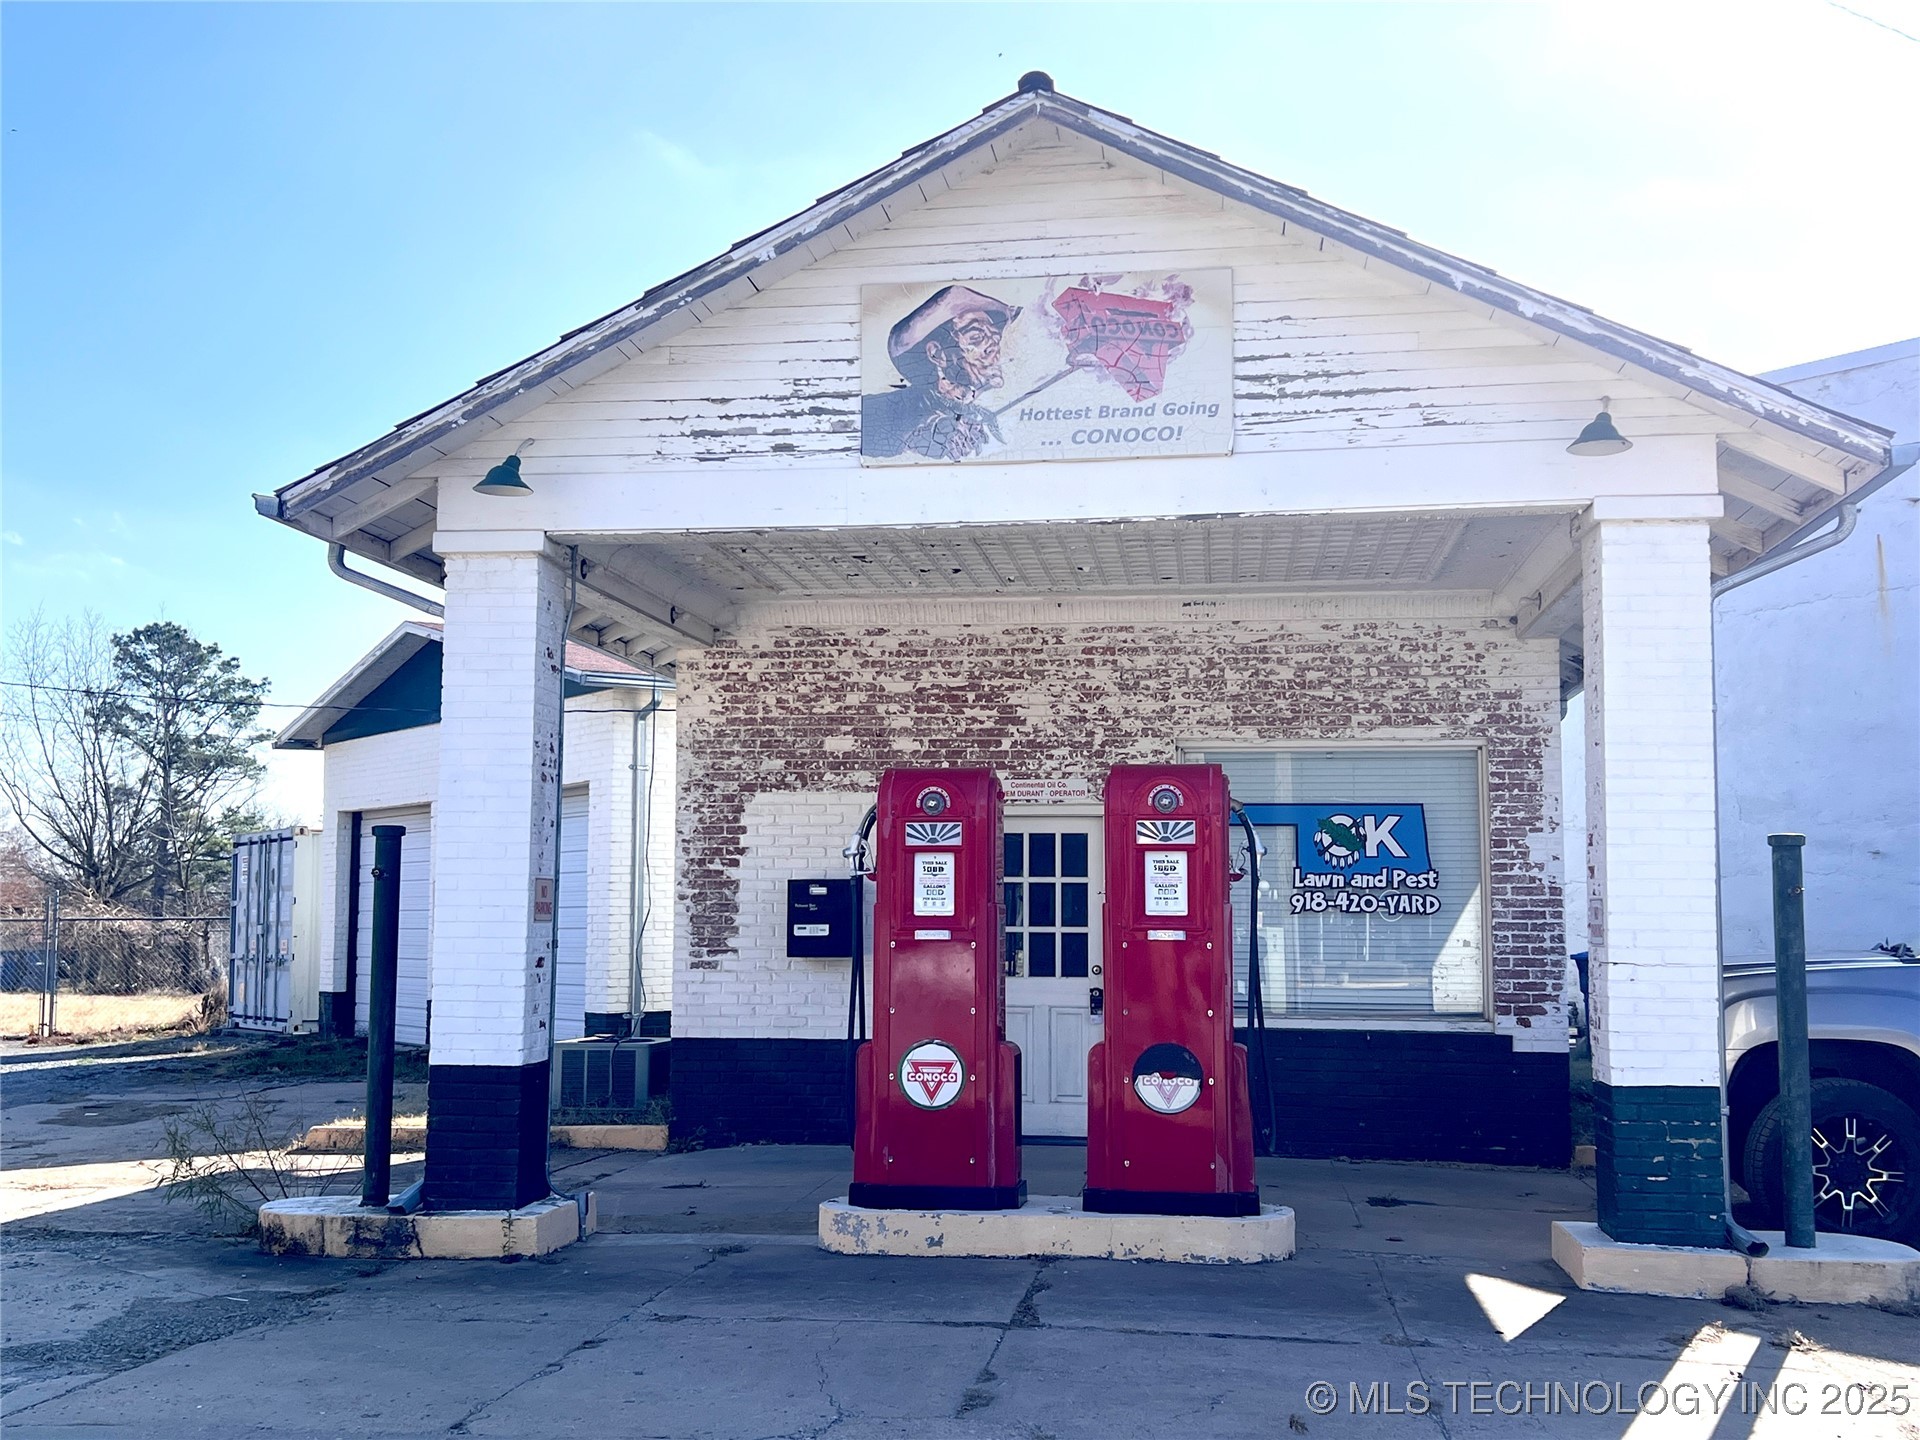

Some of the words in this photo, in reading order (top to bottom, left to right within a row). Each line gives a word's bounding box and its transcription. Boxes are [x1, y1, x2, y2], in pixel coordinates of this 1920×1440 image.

[1019, 406, 1092, 421] Hottest
[1098, 403, 1157, 419] Brand
[1162, 401, 1220, 418] Going
[1071, 426, 1184, 445] CONOCO!
[1010, 781, 1045, 789] Continental
[1047, 781, 1056, 789] Oil
[1057, 781, 1068, 789] Co.
[1049, 789, 1086, 797] OPERATOR
[1293, 866, 1345, 888] Lawn
[1350, 867, 1389, 889] and
[1392, 869, 1439, 889] Pest
[1290, 891, 1441, 915] 918-420-YARD
[908, 1072, 956, 1082] CONOCO
